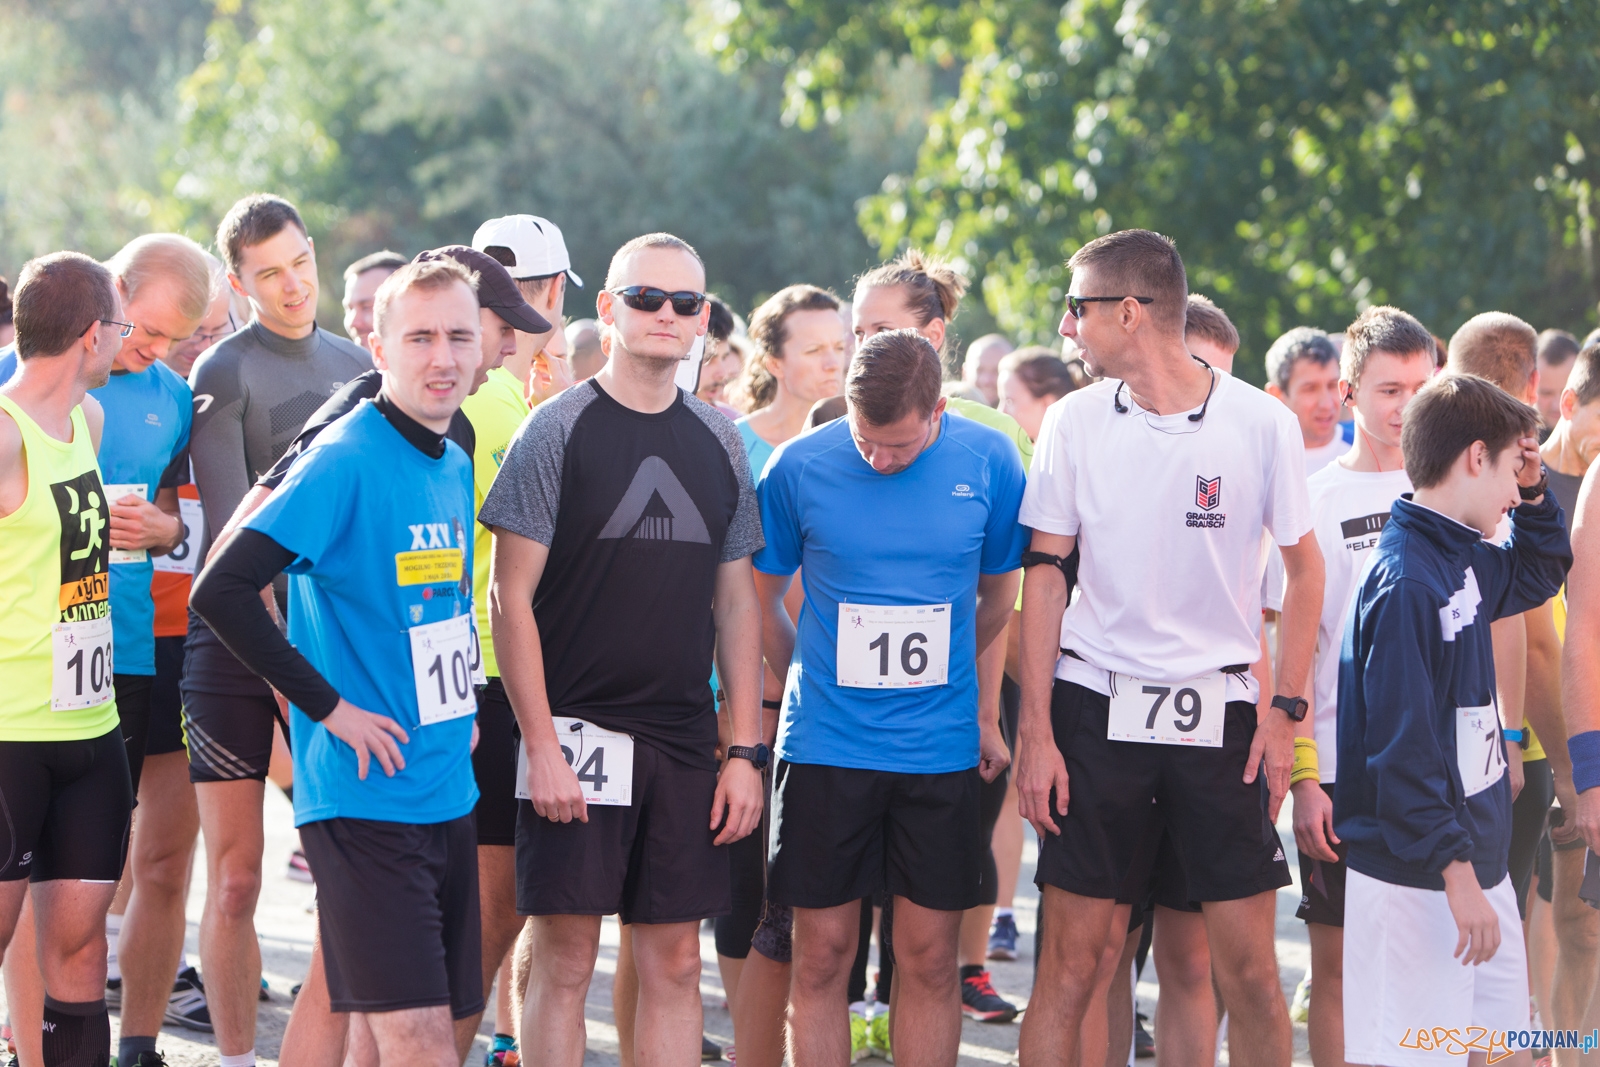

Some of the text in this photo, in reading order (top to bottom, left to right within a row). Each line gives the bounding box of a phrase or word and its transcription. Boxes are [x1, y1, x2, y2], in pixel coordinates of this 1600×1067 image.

[1186, 512, 1225, 521] GRAUSCH
[1186, 520, 1225, 528] GRAUSCH
[67, 641, 111, 696] 103
[869, 632, 928, 676] 16
[1141, 685, 1202, 733] 79
